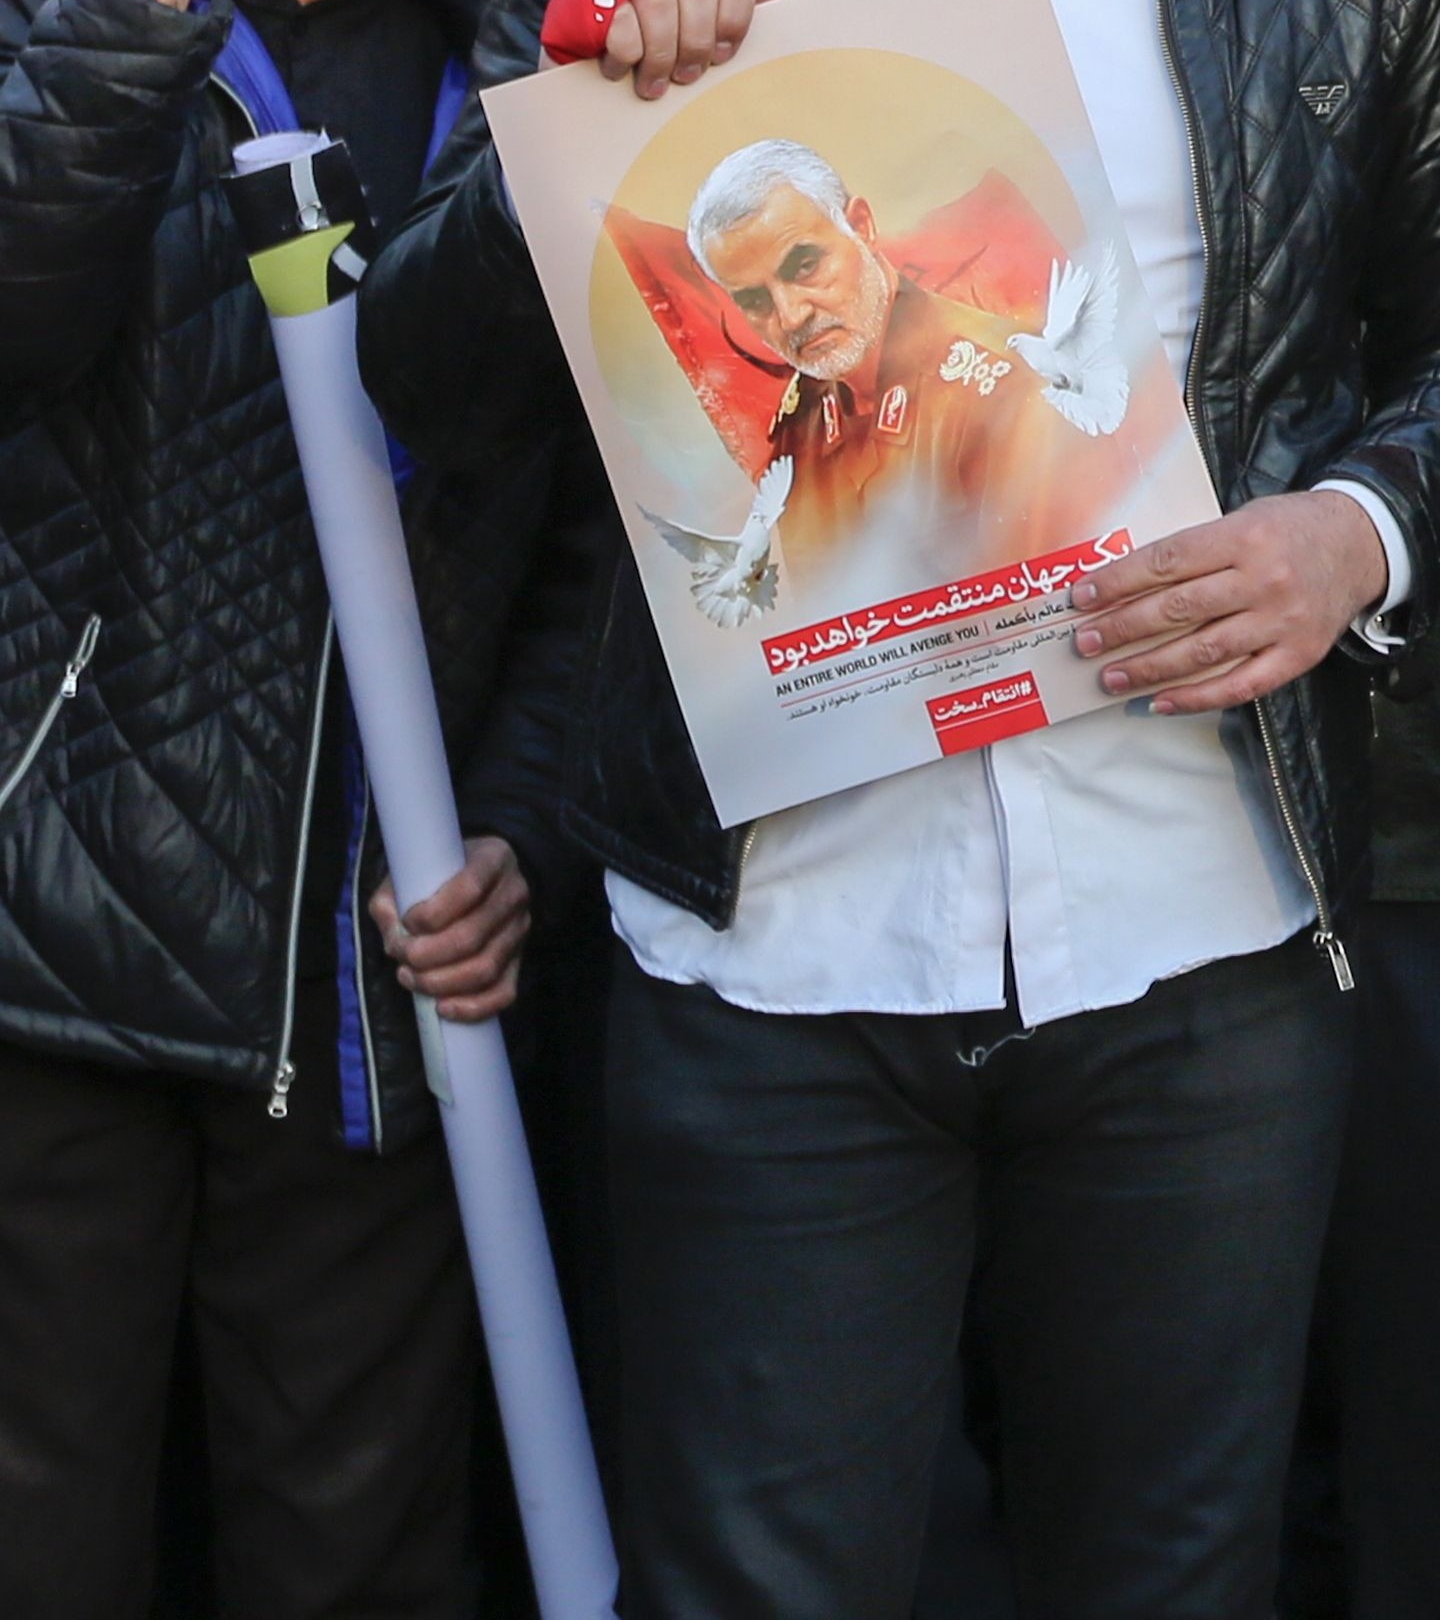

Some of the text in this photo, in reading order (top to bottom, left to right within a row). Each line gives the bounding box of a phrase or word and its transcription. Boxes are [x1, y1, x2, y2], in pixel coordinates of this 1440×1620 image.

[1009, 556, 1074, 602] جهان
[892, 580, 1006, 629] منتقمت
[809, 611, 891, 650] خواهد
[770, 641, 810, 673] بود
[775, 625, 980, 698] AN ENTIRE WORLD WILL AVENGE YOU
